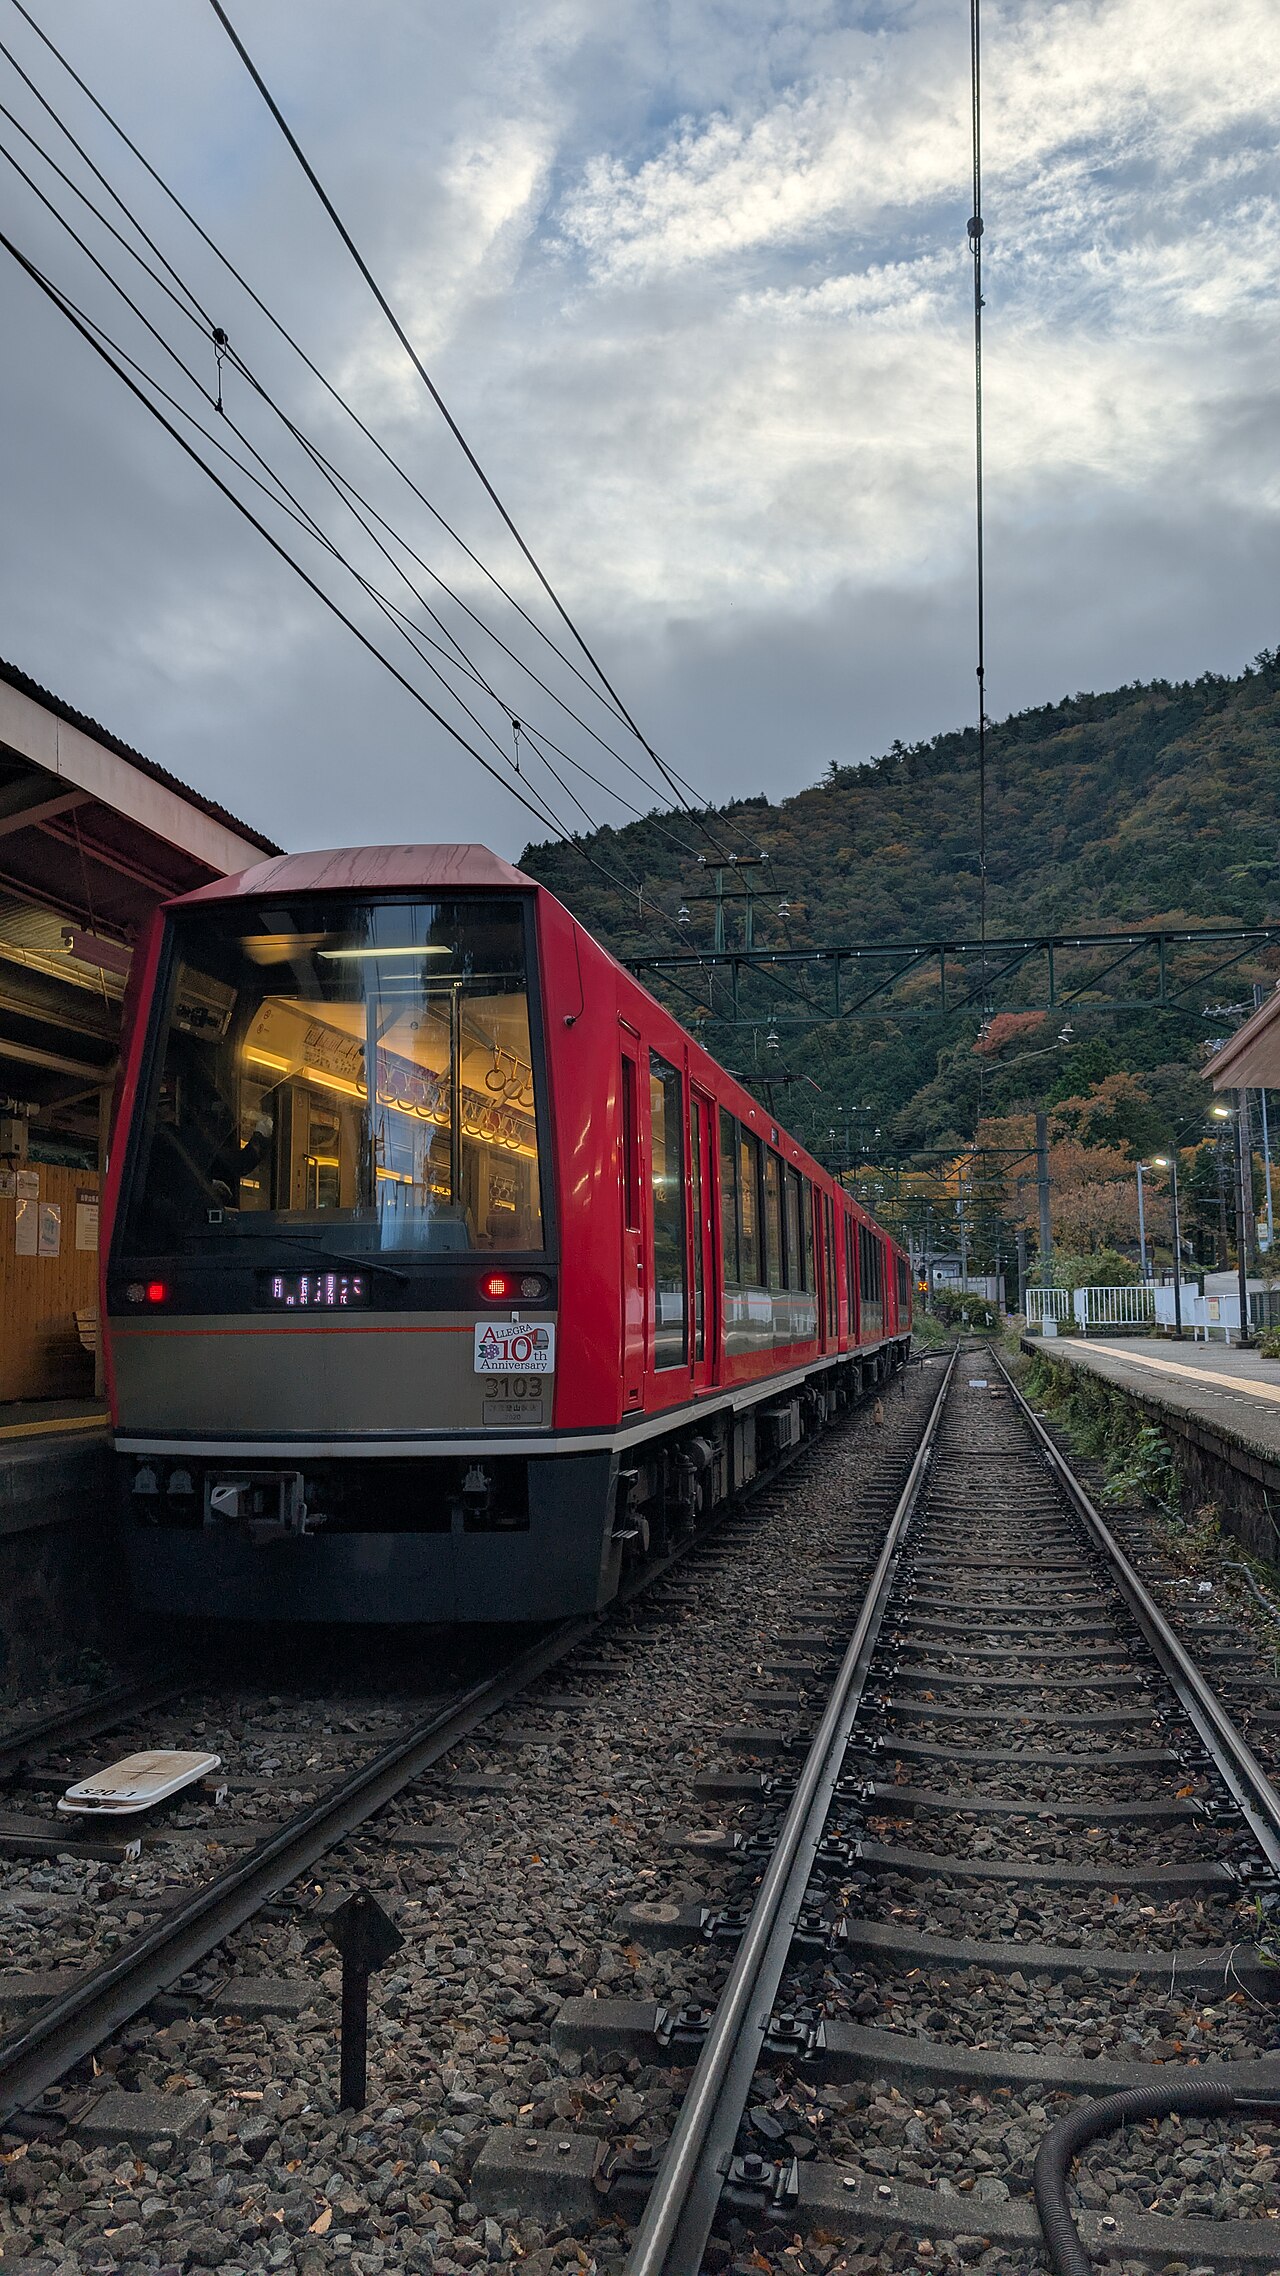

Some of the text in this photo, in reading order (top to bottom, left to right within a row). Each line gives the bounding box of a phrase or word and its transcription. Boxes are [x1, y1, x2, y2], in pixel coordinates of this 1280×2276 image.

[480, 1323, 533, 1344] ALLEGRA
[480, 1359, 548, 1371] Anniversary
[485, 1376, 543, 1398] 3103
[79, 1788, 137, 1797] S20-1
